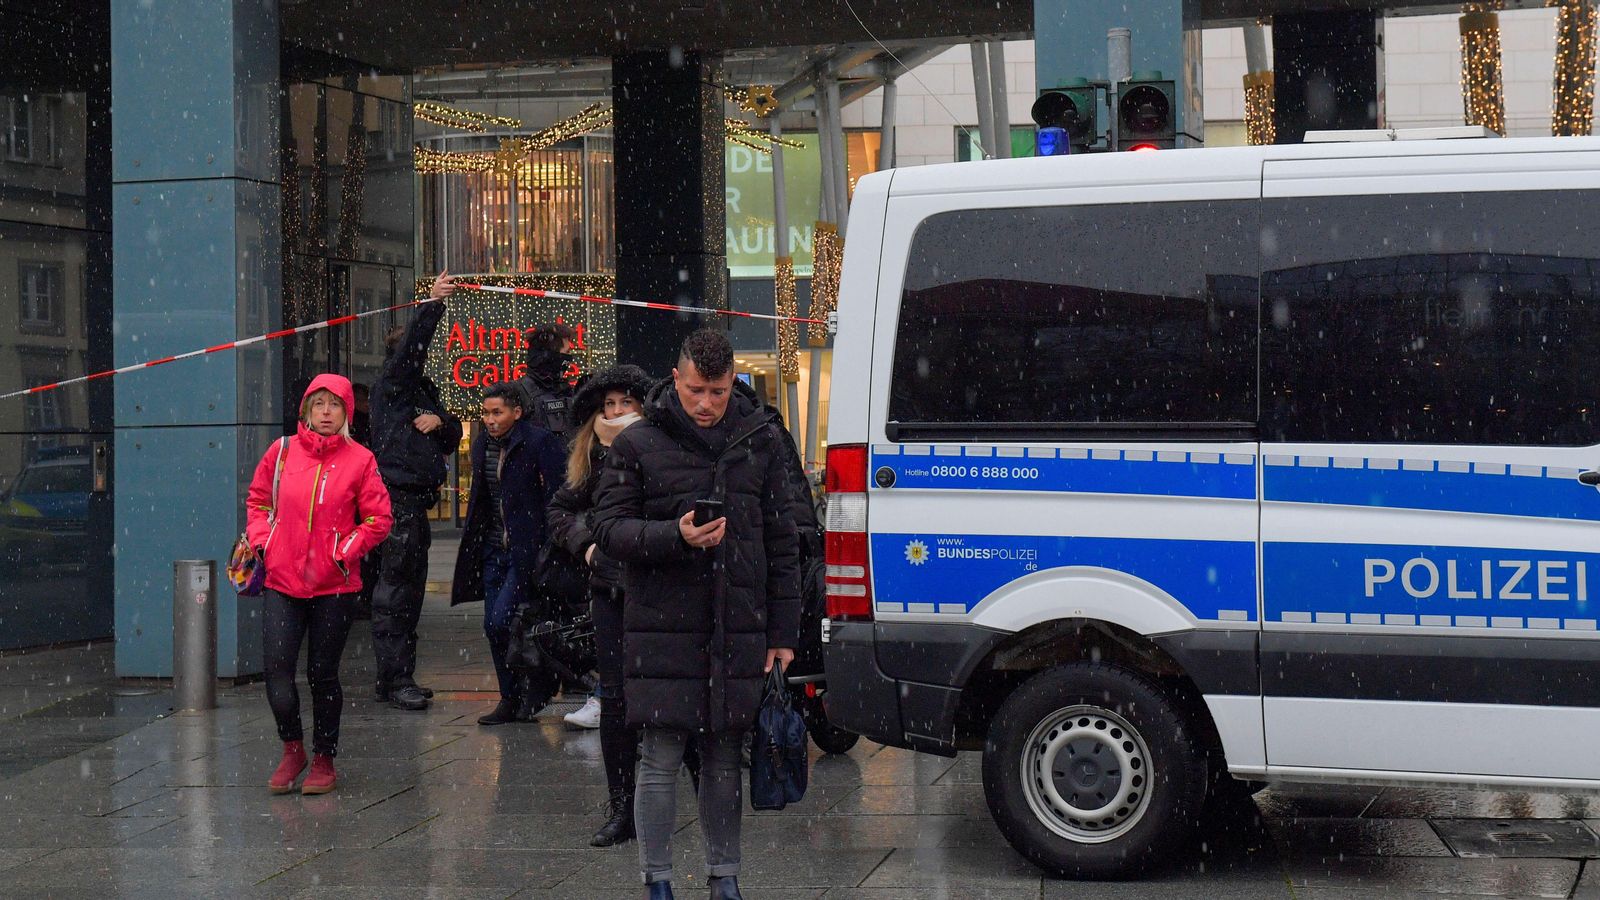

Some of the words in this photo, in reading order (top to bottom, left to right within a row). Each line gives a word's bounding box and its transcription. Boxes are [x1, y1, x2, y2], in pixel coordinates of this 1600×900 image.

[547, 401, 564, 410] POLIZEI
[905, 468, 929, 477] Hotline
[931, 466, 967, 477] 0800
[970, 466, 979, 478] 6
[982, 467, 1009, 478] 888
[1011, 467, 1039, 479] 000
[937, 538, 965, 546] www.
[938, 547, 1038, 560] BUNDESPOLIZEI
[1023, 561, 1038, 571] .de
[1364, 557, 1587, 601] POLIZEI
